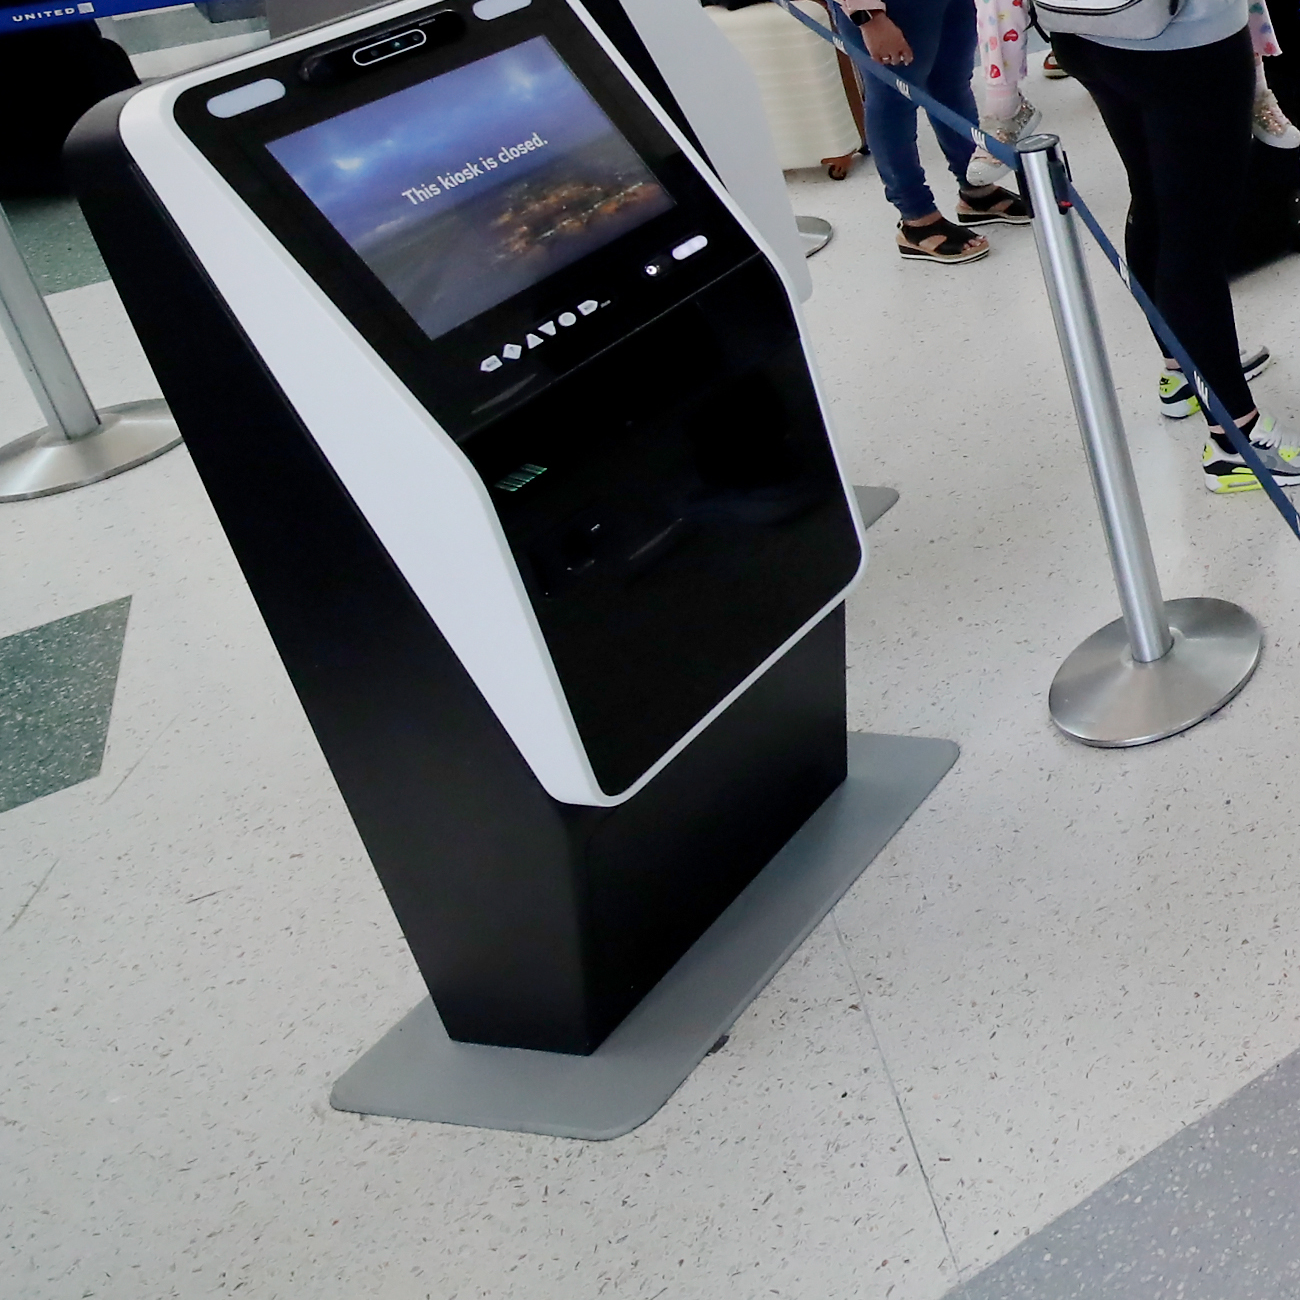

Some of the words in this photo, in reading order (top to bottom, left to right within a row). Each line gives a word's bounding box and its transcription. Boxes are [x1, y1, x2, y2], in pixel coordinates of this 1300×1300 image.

[12, 7, 76, 22] UNITED
[401, 183, 442, 205] This
[437, 162, 485, 190] kiosk
[478, 156, 499, 171] is
[498, 131, 549, 164] closed.
